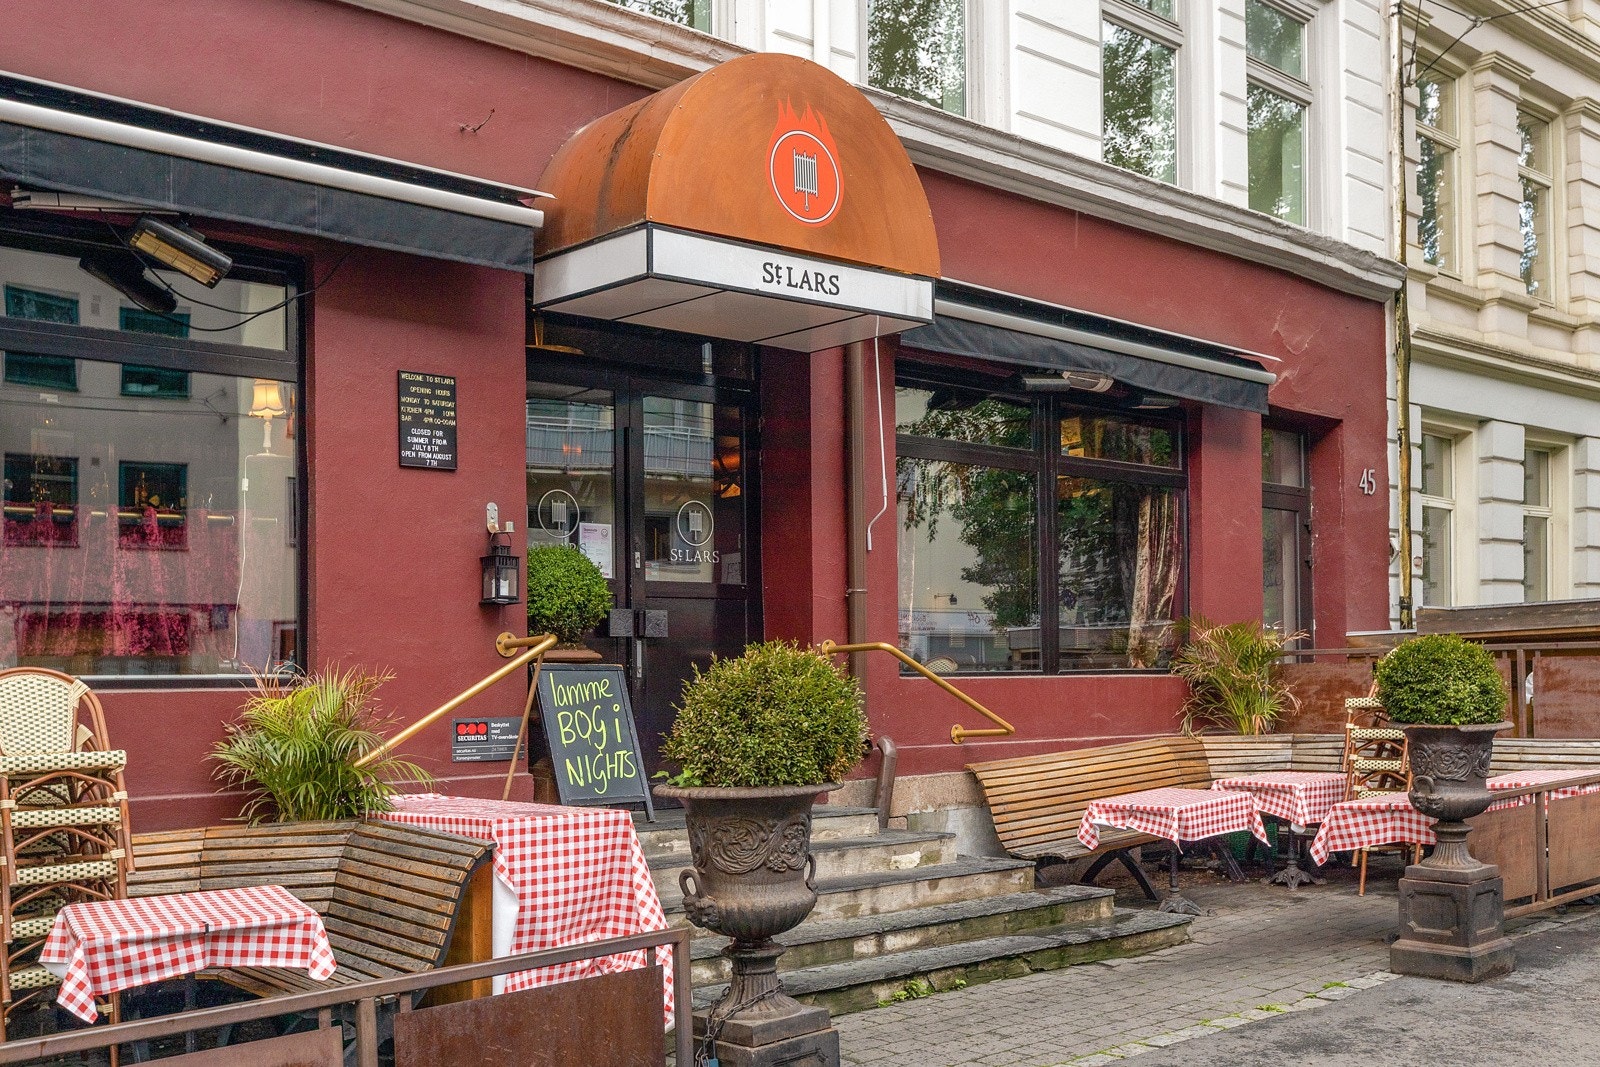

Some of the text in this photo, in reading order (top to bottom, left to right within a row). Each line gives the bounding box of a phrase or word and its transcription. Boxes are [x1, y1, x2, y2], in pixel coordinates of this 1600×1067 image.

[786, 266, 840, 296] LARS
[401, 373, 424, 381] WELCOME
[410, 386, 431, 394] OPENING
[401, 396, 420, 404] MONDAY
[432, 399, 455, 408] SATURDAY
[1359, 468, 1376, 495] 45
[686, 550, 720, 563] LARS
[566, 750, 637, 794] NIGHTS
